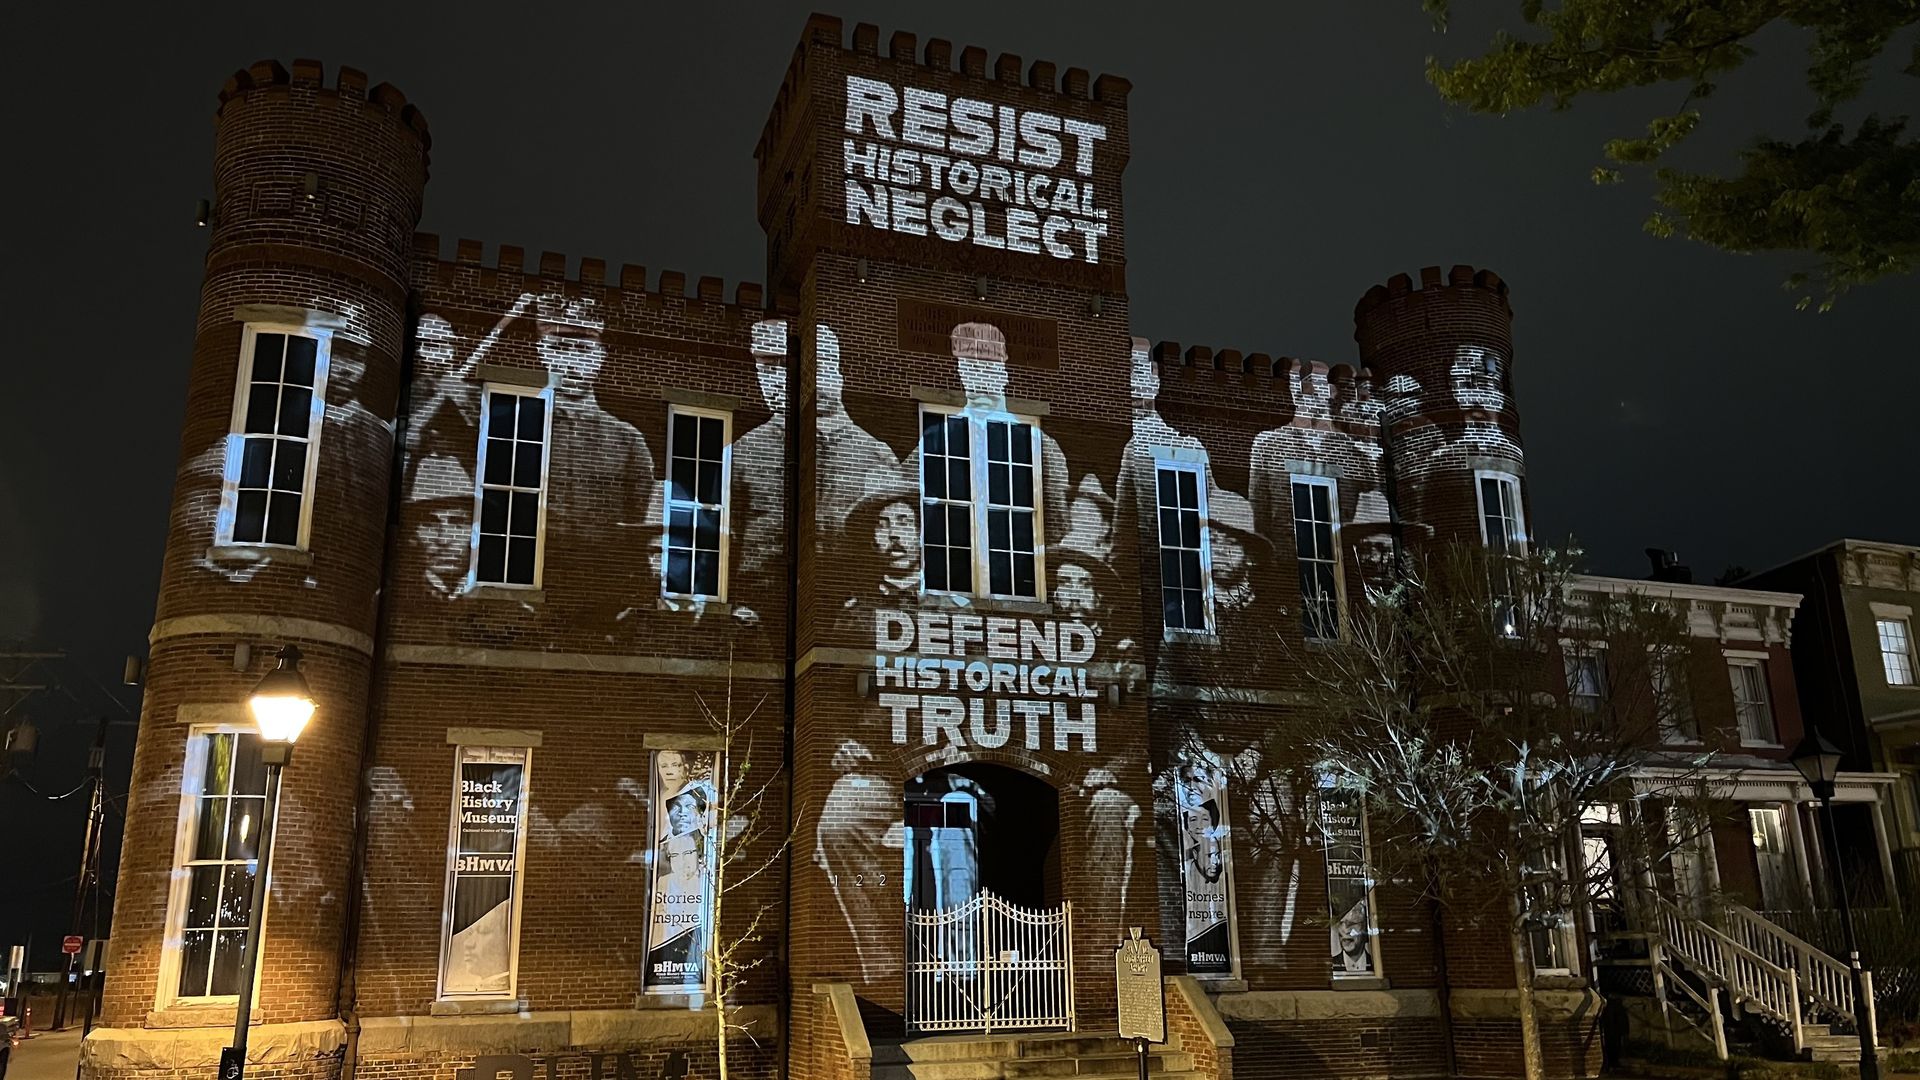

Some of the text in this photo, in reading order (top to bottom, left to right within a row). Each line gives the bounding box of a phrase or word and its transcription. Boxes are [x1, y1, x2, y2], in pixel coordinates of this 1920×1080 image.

[844, 75, 1107, 177] RESIST
[844, 139, 1108, 219] HISTORICAL
[844, 179, 1108, 264] NEGLECT
[875, 608, 1096, 663] DEFEND
[875, 655, 1099, 698] HISTORICAL
[878, 693, 1098, 752] TRUTH
[462, 780, 503, 793] Black
[462, 796, 513, 811] History
[461, 812, 517, 824] Museum
[458, 856, 513, 871] BHMVA
[655, 891, 703, 904] Stories
[1187, 890, 1225, 902] Stories
[656, 910, 702, 926] nspire.
[1188, 907, 1226, 922] nspire.
[1190, 952, 1226, 961] BHMVA
[653, 961, 699, 972] BHMVA
